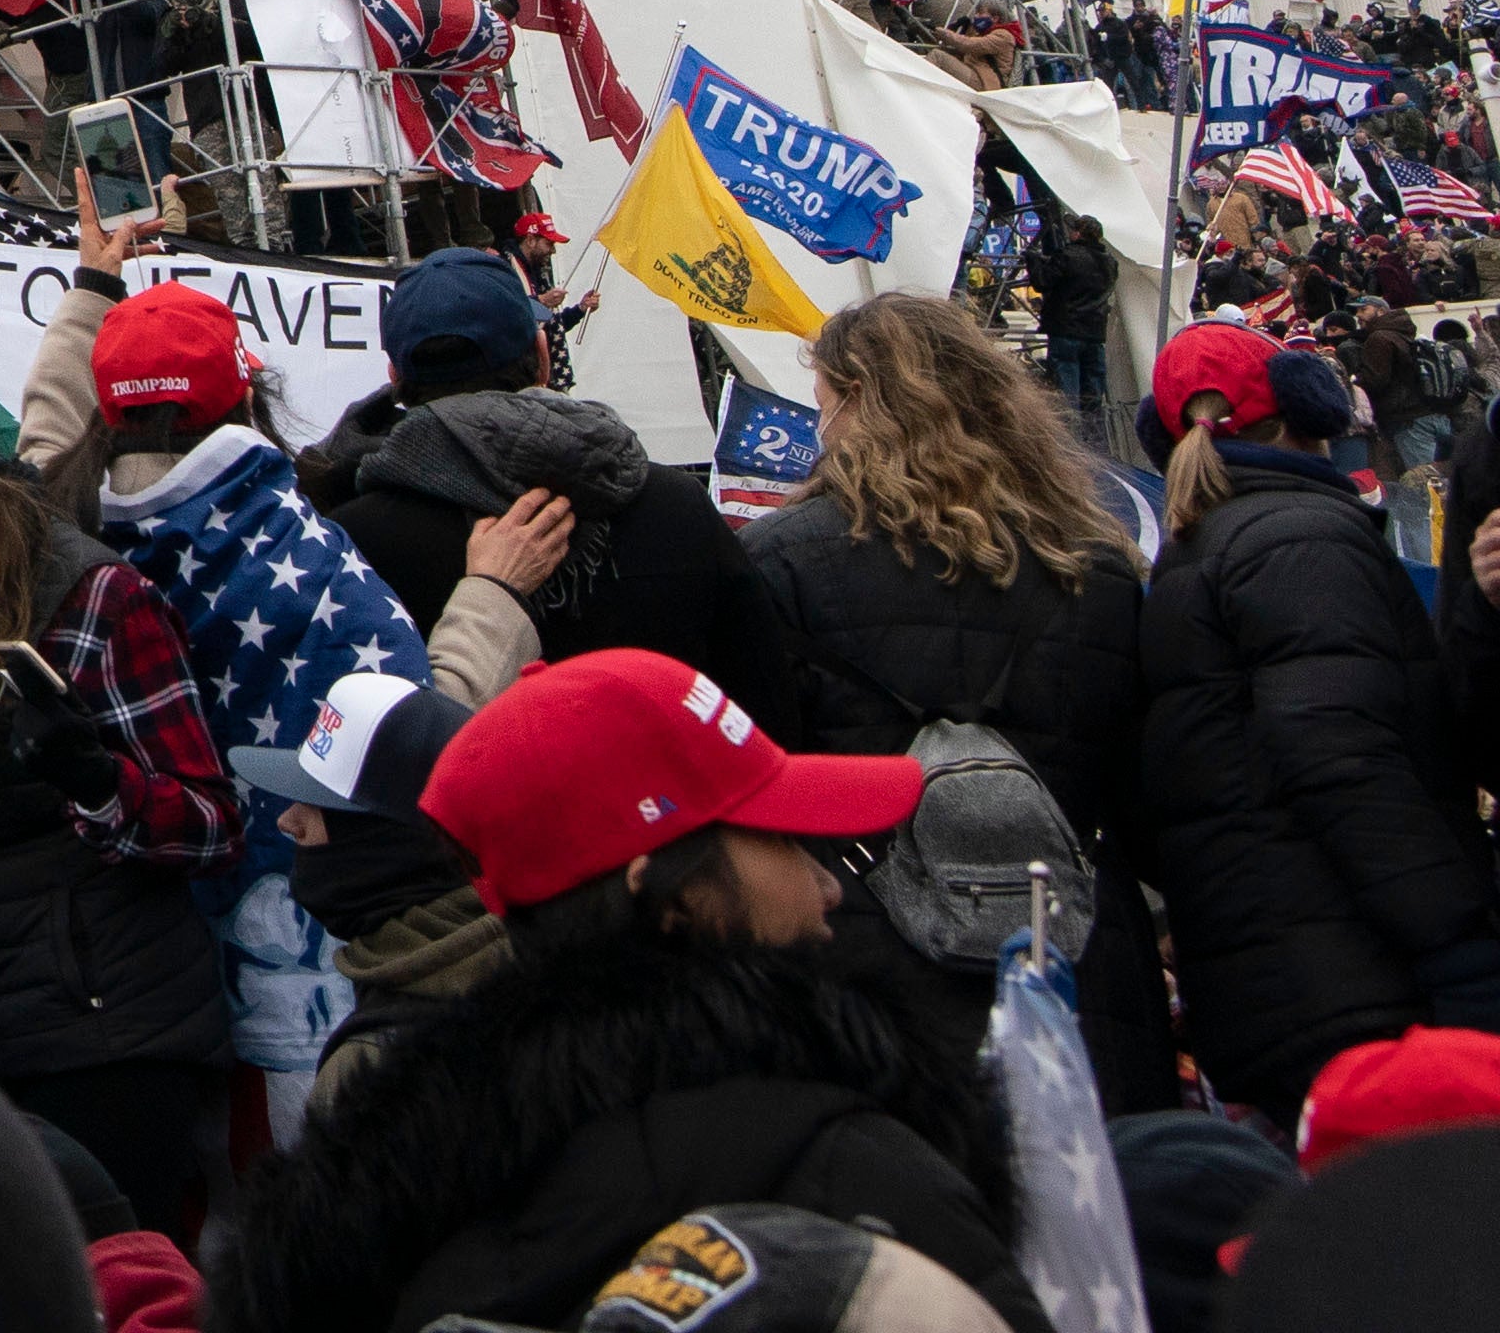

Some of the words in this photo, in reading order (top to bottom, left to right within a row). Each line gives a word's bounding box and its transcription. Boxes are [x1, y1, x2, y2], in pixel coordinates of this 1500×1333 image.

[703, 83, 902, 200] TRUMP
[686, 290, 732, 320] TREAD
[736, 315, 759, 325] ON
